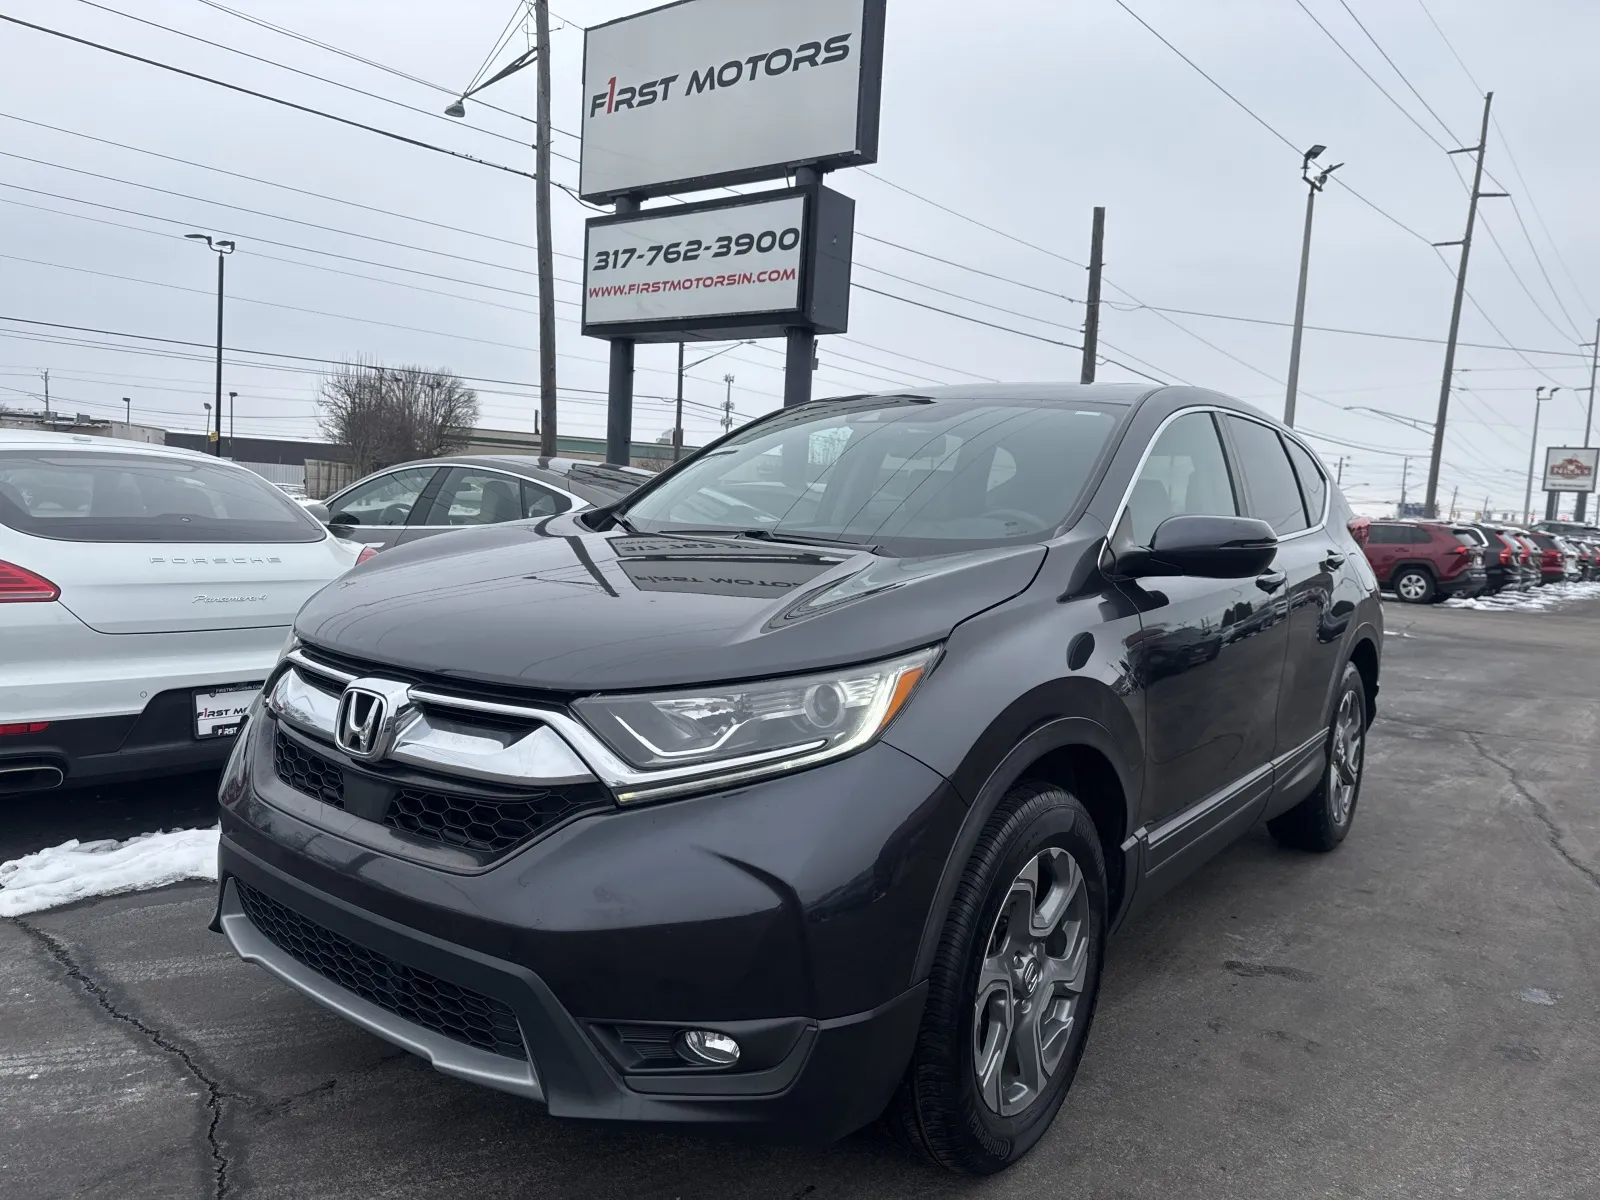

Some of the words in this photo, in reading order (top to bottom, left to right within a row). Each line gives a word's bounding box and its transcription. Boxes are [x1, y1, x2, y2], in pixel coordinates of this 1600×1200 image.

[685, 33, 852, 96] MOTORS
[592, 227, 800, 271] 317-762-3900
[589, 268, 796, 298] WWW.FIRSTMOTORSIN.COM
